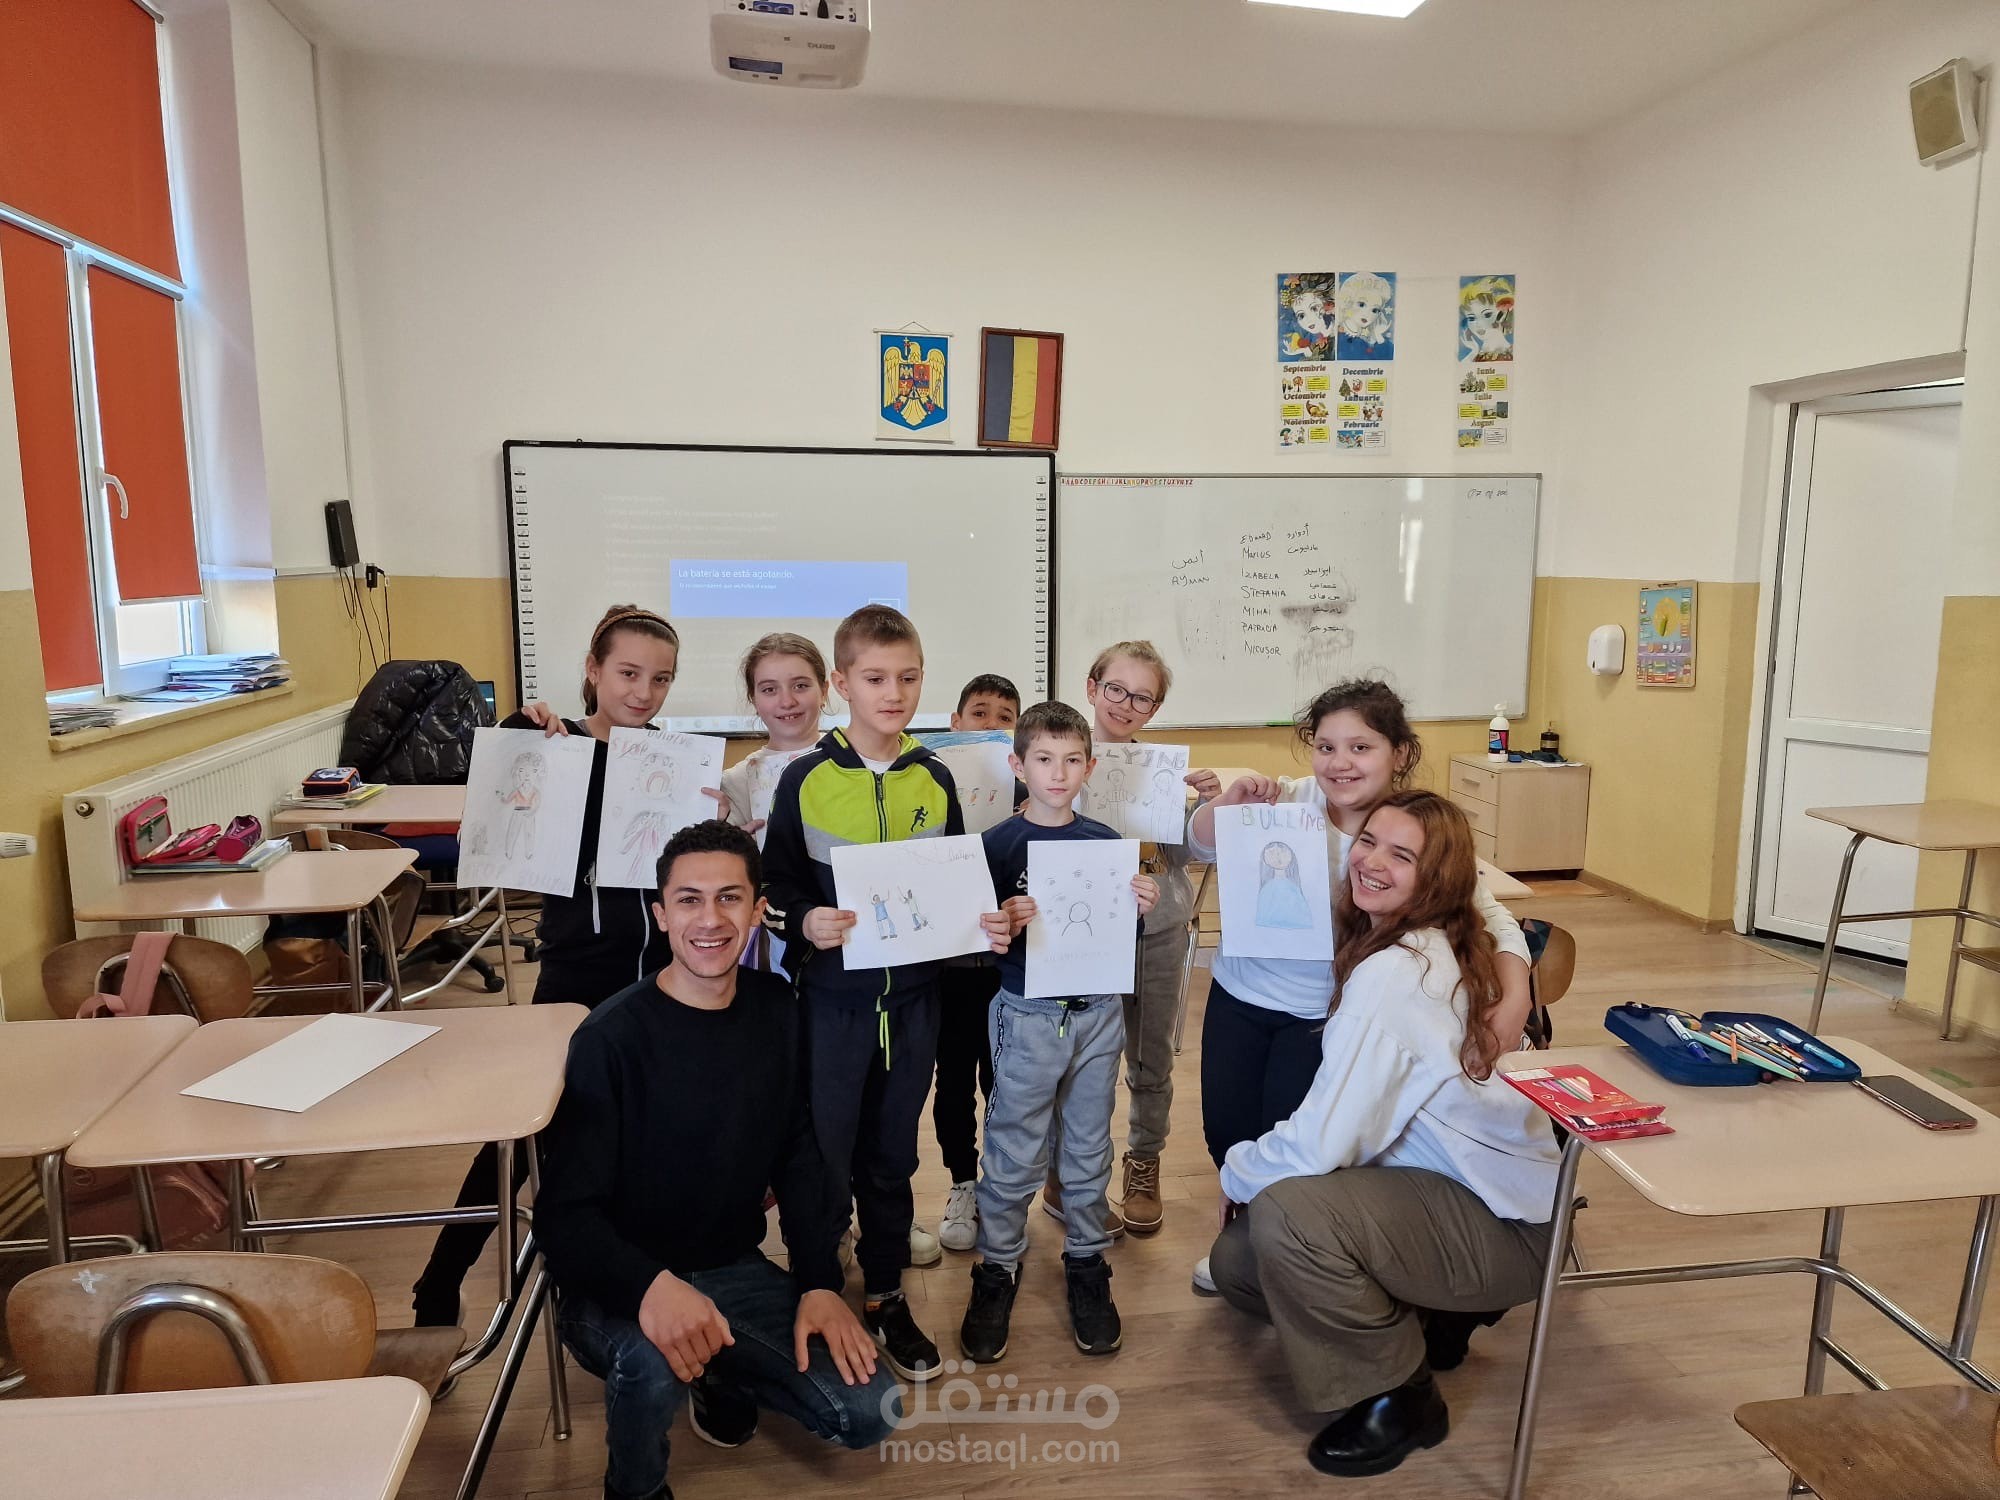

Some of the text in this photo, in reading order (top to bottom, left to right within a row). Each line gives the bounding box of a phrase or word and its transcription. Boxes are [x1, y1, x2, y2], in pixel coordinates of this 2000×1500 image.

[1283, 364, 1327, 374] Septembrie
[1342, 368, 1384, 376] Decembrie
[1284, 392, 1326, 400] Octombrie
[678, 569, 688, 578] La
[721, 570, 731, 578] se
[733, 569, 750, 578] está
[1242, 605, 1271, 617] MIHAI
[1093, 745, 1187, 770] LYING
